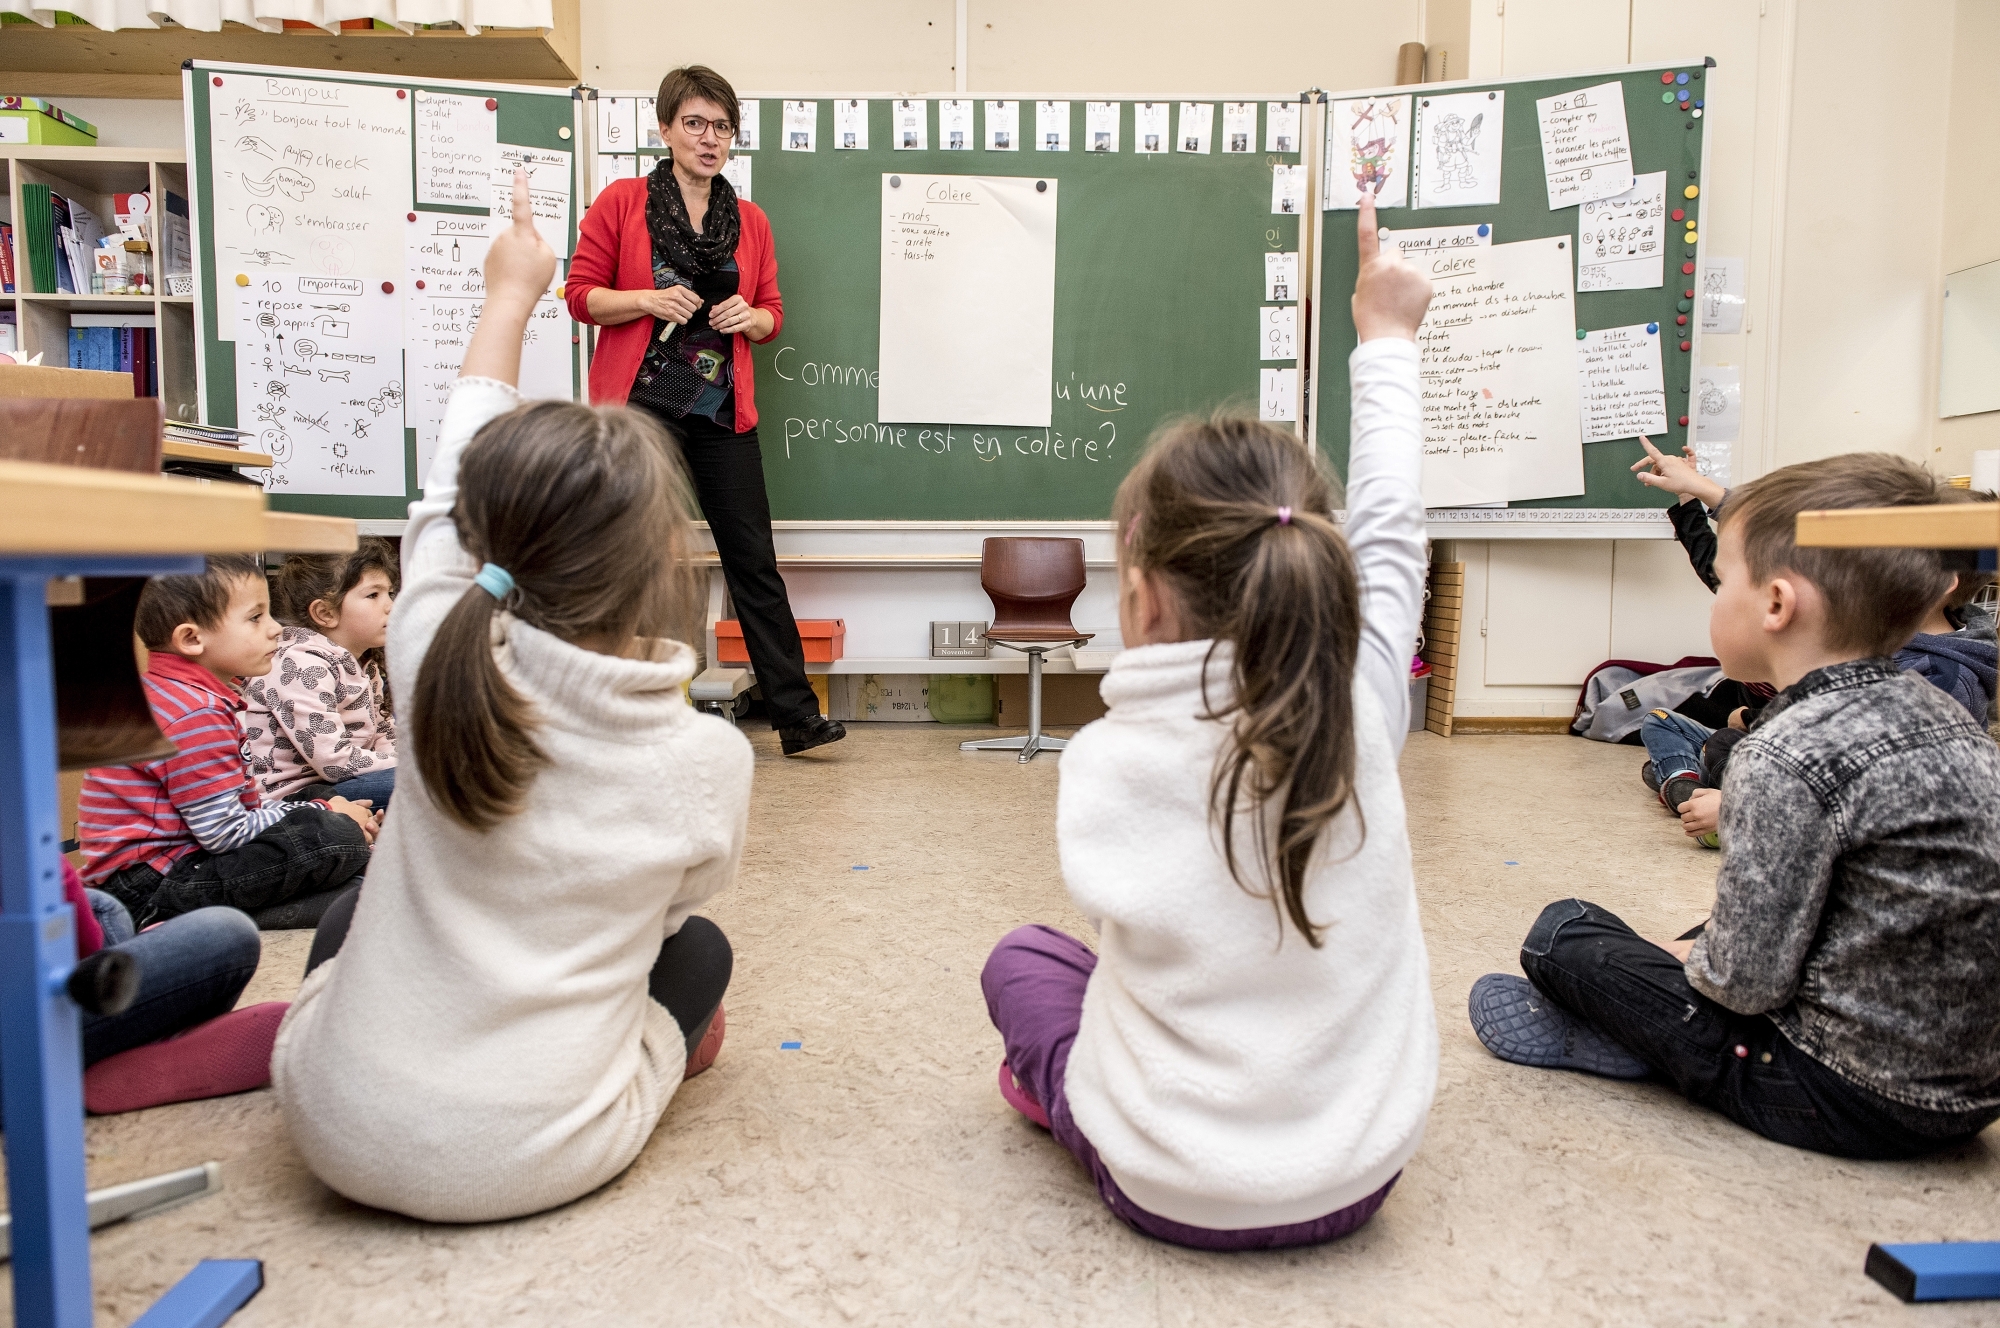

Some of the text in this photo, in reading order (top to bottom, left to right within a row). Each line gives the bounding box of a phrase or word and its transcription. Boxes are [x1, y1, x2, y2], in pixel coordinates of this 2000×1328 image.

[265, 79, 341, 102] Bonjour
[1554, 101, 1568, 111] Dé
[426, 108, 452, 119] salut
[1550, 115, 1582, 125] compter
[273, 110, 406, 136] bonjour tout le monde
[431, 121, 441, 131] Hi
[607, 111, 621, 139] le
[1552, 125, 1579, 137] jouer
[430, 133, 454, 143] ciao
[1554, 135, 1577, 145] tirer
[1556, 136, 1621, 154] avancer les pions
[316, 153, 370, 170] check
[431, 147, 482, 163] bonjorno
[1554, 153, 1589, 166] apprendre
[1592, 149, 1602, 158] les
[431, 166, 491, 180] good morning
[430, 177, 473, 190] bunos dias
[1555, 176, 1575, 184] cube
[331, 186, 372, 201] salut
[926, 181, 973, 201] Colère
[1559, 184, 1580, 196] points
[902, 208, 931, 222] mots
[295, 214, 370, 231] s'embrasser
[436, 220, 487, 235] pouvoir
[901, 227, 919, 235] vous
[905, 236, 933, 247] arrête
[1399, 235, 1475, 254] quand je dors
[420, 243, 444, 256] colle
[1432, 258, 1476, 274] Colère
[262, 280, 282, 293] 10
[302, 279, 359, 292] important
[439, 281, 452, 292] ne
[1451, 286, 1462, 295] ta
[1467, 281, 1505, 293] chambre
[258, 300, 303, 314] repose
[1443, 300, 1479, 310] moment
[432, 304, 465, 320] loups
[283, 317, 315, 333] appris
[432, 322, 462, 332] ours
[435, 336, 464, 349] parents
[1604, 331, 1627, 341] titre
[1506, 344, 1514, 354] le
[784, 417, 907, 459] personne
[918, 423, 956, 454] est
[973, 432, 1002, 456] en
[1426, 512, 1658, 520] 10 11 12 13 14 15 16 17 18 19 20 21 22 23 24 25 26 27 28 29
